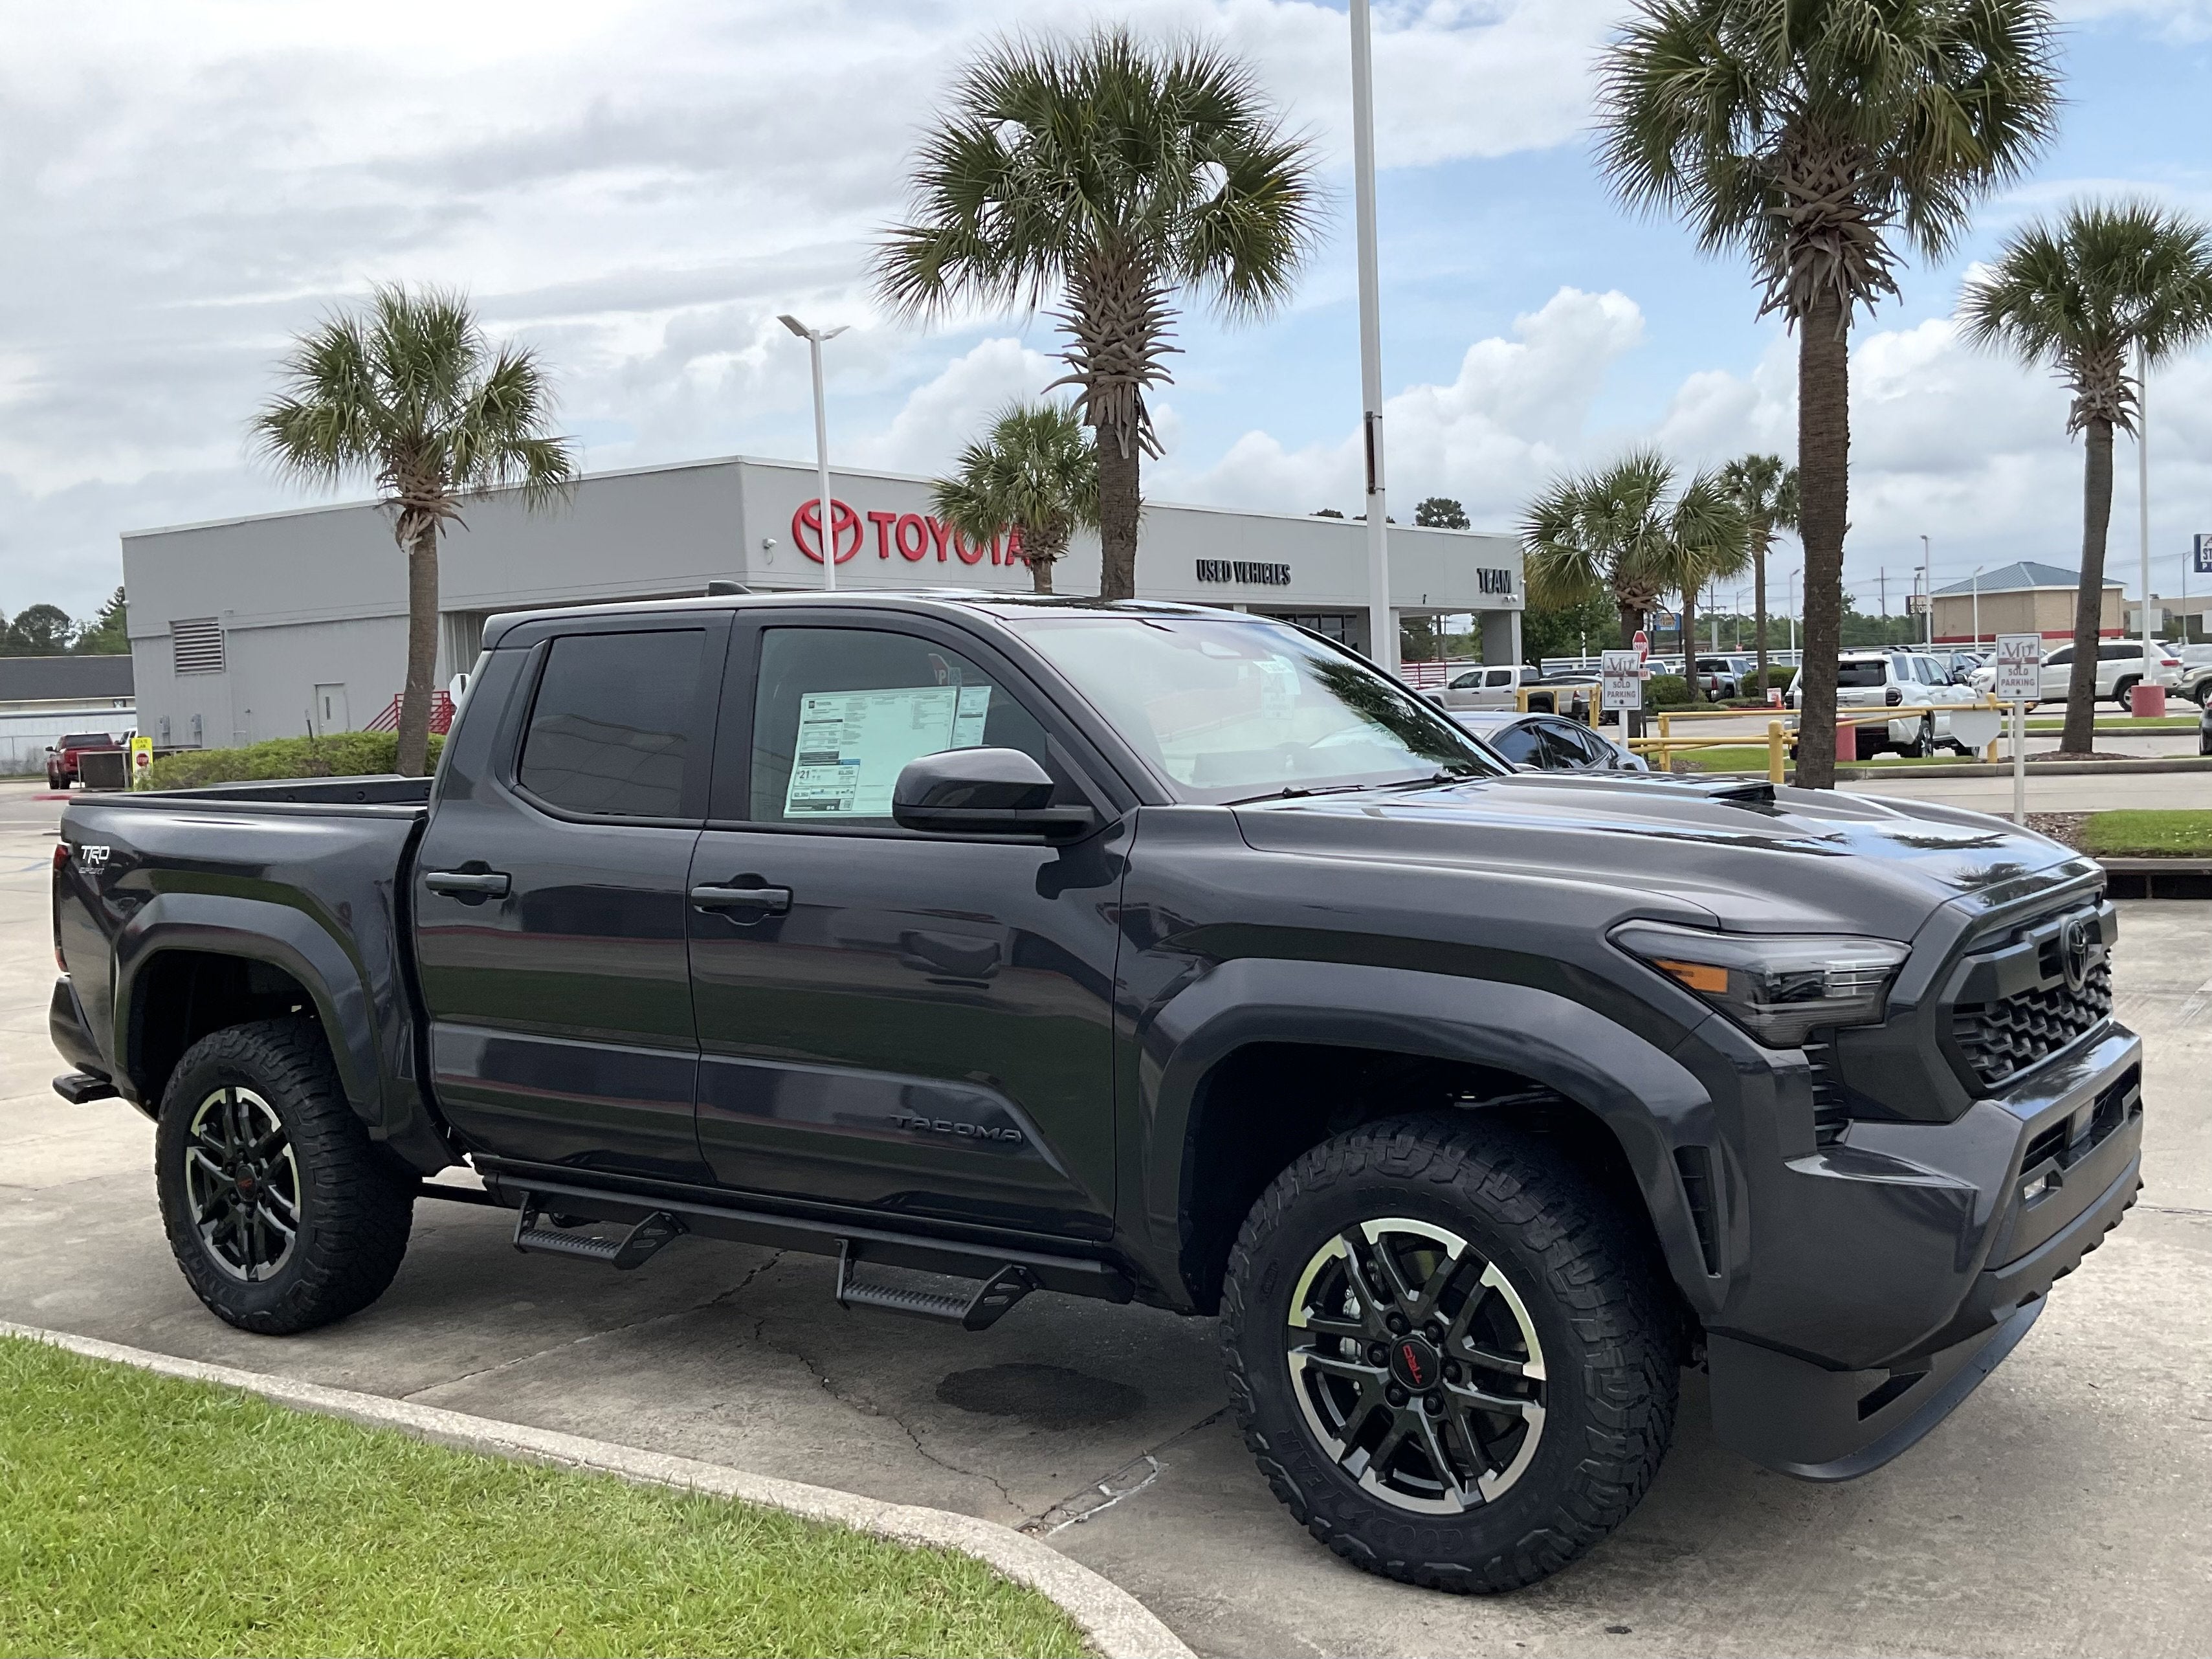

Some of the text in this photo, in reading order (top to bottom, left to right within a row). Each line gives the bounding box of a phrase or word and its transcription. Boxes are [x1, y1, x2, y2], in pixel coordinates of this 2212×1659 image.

[1197, 559, 1291, 585] USED VEHICLES
[1477, 568, 1512, 593] TEAM
[1633, 641, 1647, 652] STOP
[799, 770, 810, 779] 21
[81, 845, 110, 865] TRD
[890, 1114, 1023, 1142] TACOMA
[1402, 1345, 1422, 1384] TRD
